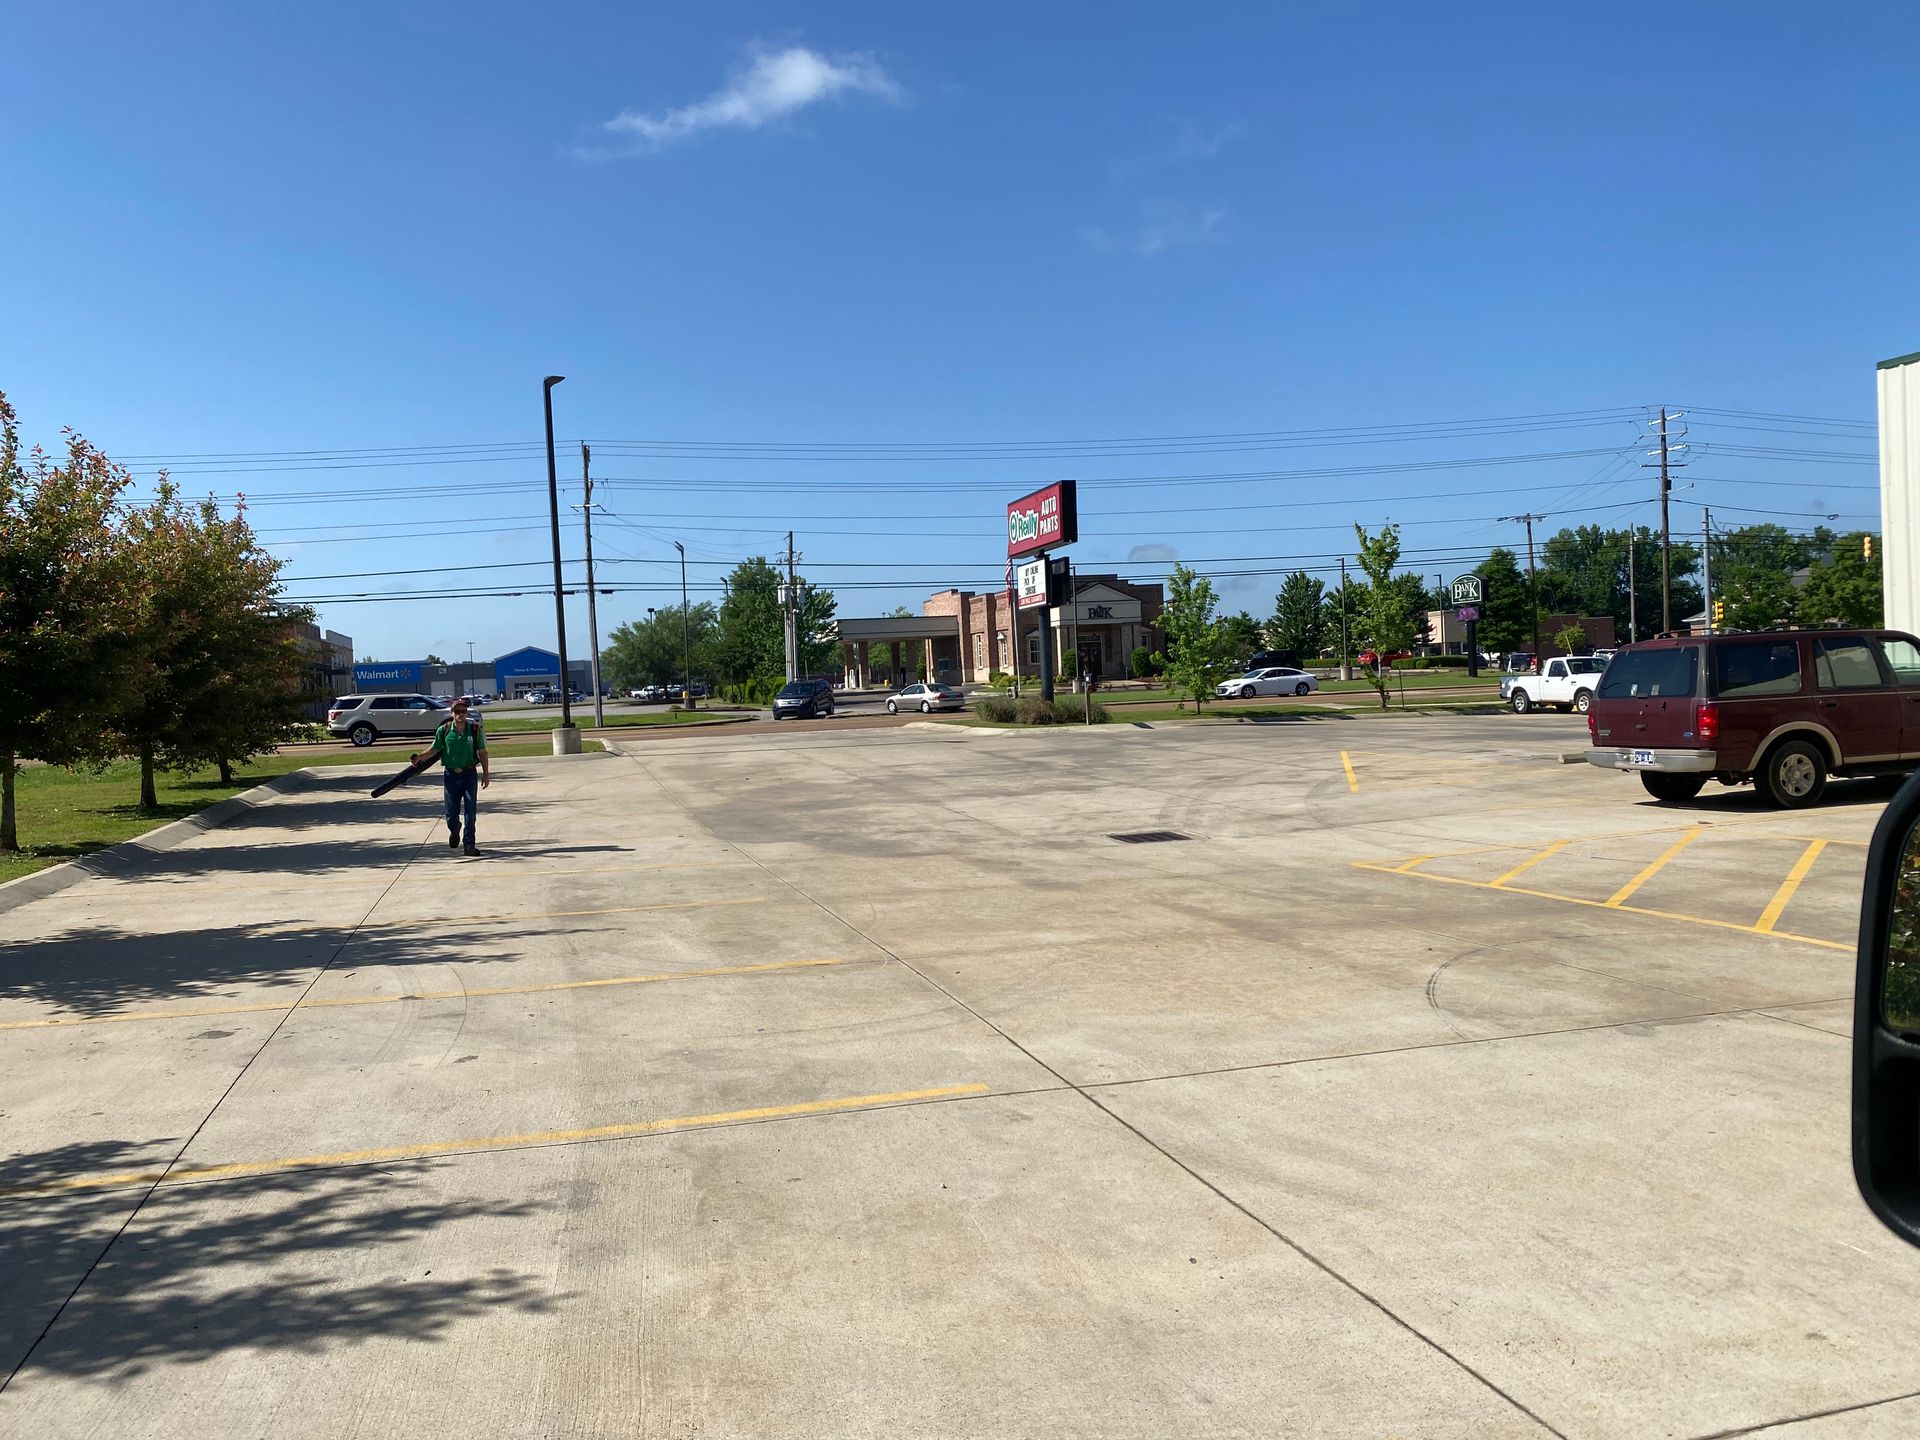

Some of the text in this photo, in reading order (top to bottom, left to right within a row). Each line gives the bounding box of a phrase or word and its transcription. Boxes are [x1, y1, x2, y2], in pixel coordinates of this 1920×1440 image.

[1041, 495, 1057, 516] AUTO
[1010, 511, 1038, 543] O'Reilly
[1039, 514, 1059, 536] PARTS
[1454, 581, 1478, 599] BANK
[356, 669, 399, 680] Walmart
